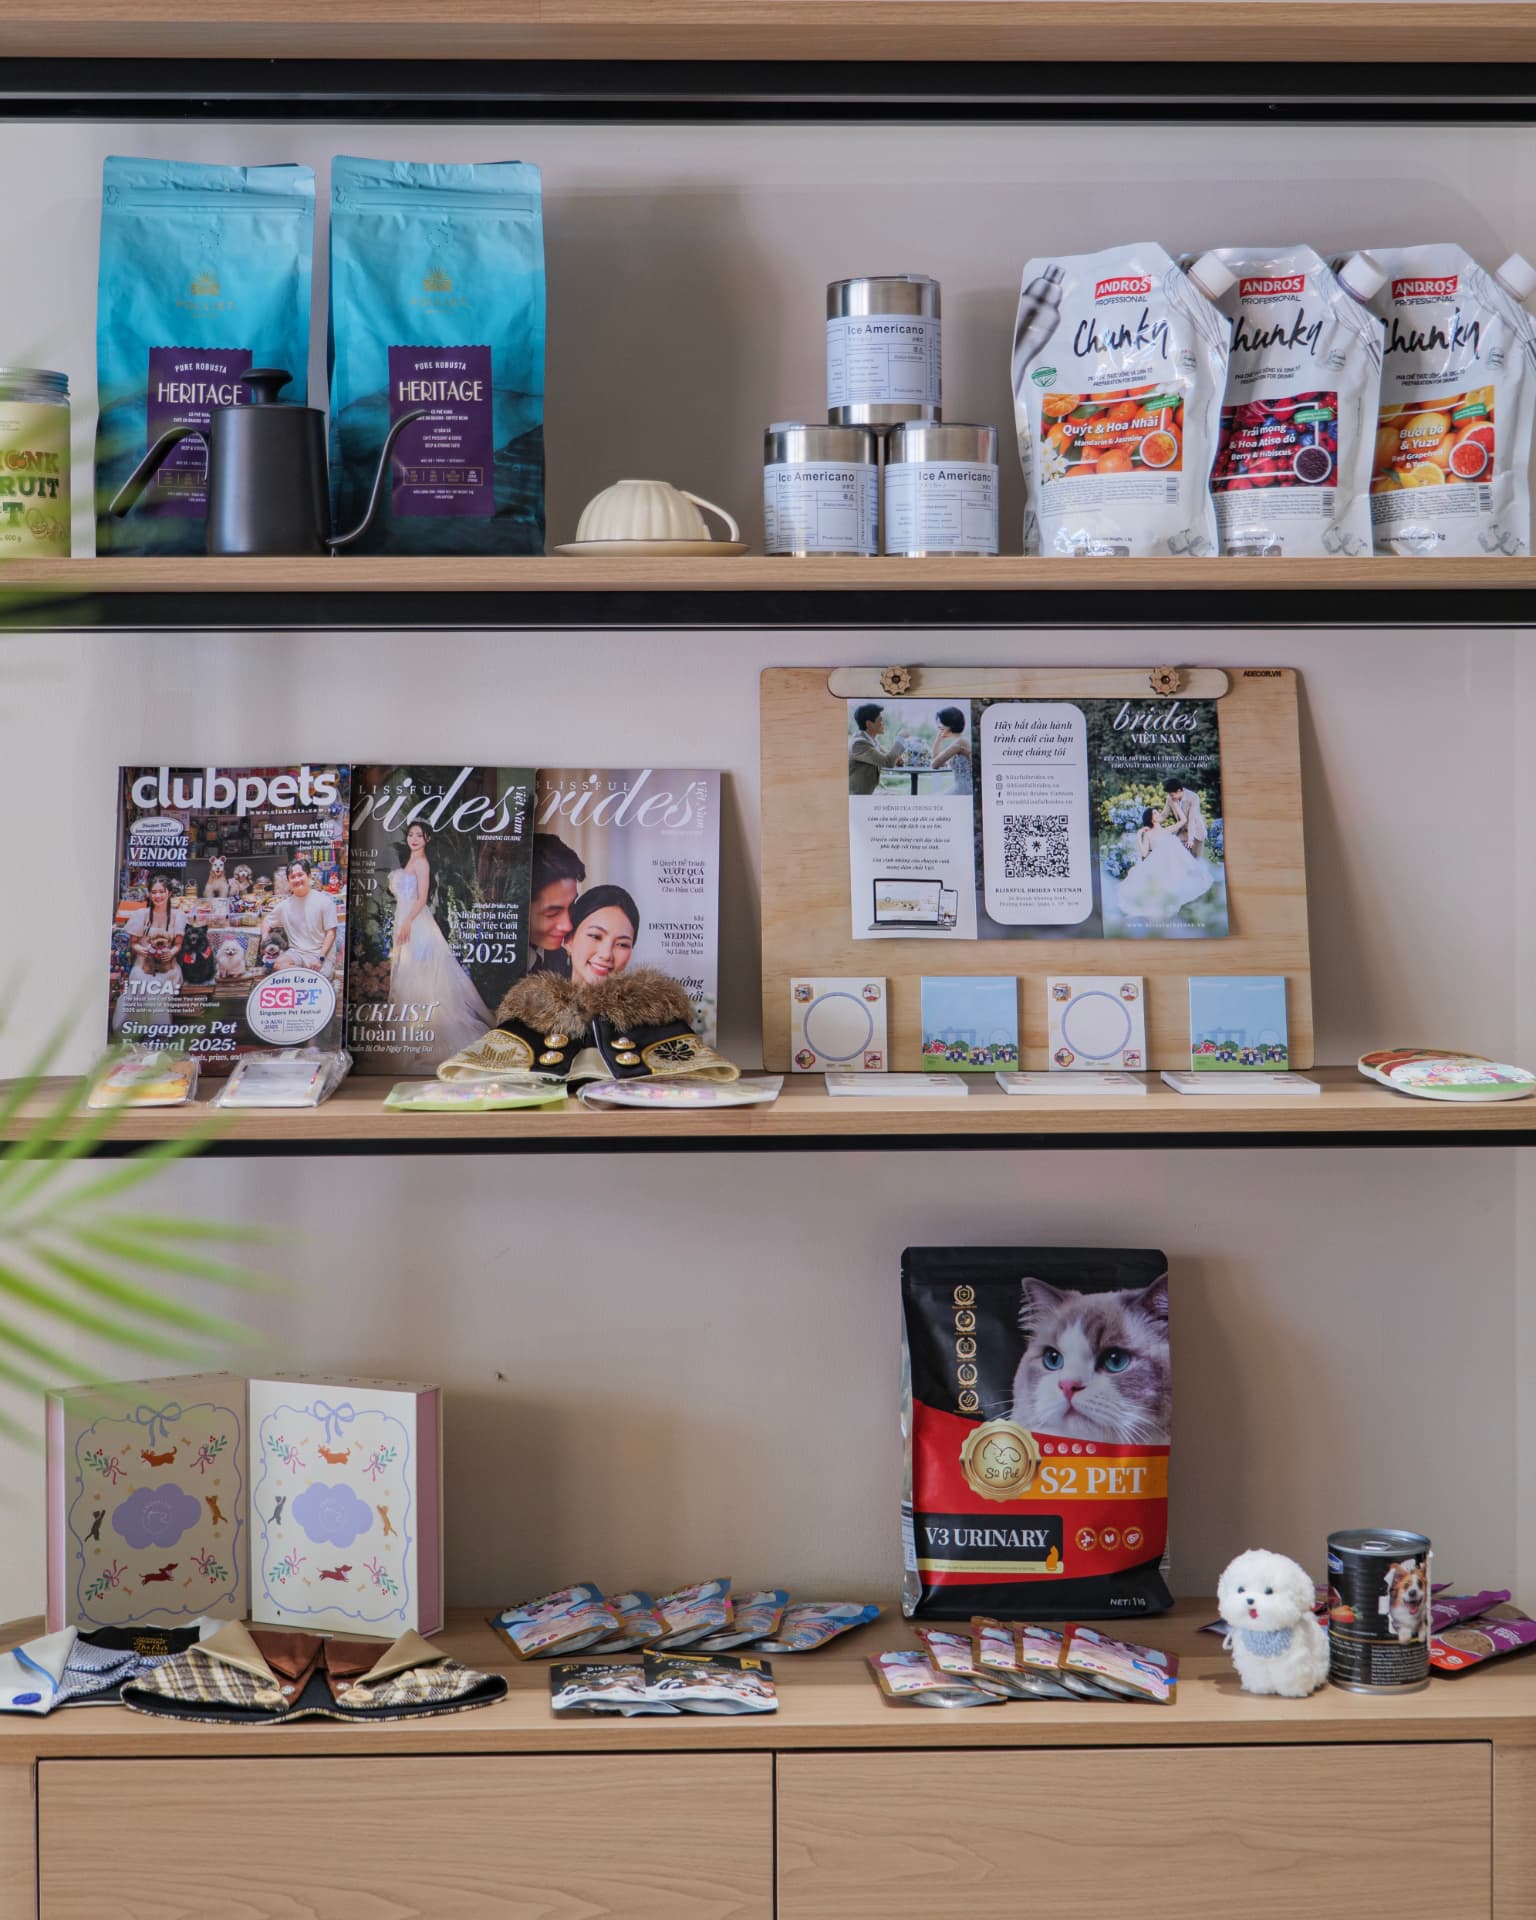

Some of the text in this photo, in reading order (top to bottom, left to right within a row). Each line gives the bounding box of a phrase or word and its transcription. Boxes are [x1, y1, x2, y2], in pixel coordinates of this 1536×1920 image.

[1097, 277, 1149, 296] ANDROS
[1242, 277, 1302, 294] ANDROS
[1395, 278, 1456, 296] ANDROS
[1095, 294, 1148, 306] PROFESSIONAL
[1241, 294, 1302, 305] PROFESSIONAL
[1394, 294, 1456, 306] PROFESSIONAL
[848, 323, 925, 335] Ice Americano
[1074, 307, 1169, 361] Chunky
[175, 362, 227, 374] PURE ROBUSTA
[415, 361, 467, 371] PURE ROBUSTA
[158, 382, 243, 405] HERITAGE
[399, 380, 484, 401] HERITAGE
[1063, 424, 1092, 437] Quýt
[1095, 424, 1105, 433] &
[1106, 421, 1129, 433] Hoa
[1242, 424, 1287, 437] Trái mọng
[1074, 438, 1107, 446] Mandarin
[1115, 435, 1143, 443] Jasmine
[1238, 440, 1257, 449] Hoa
[1259, 436, 1281, 447] Atiso
[1413, 439, 1440, 449] Yuzu
[1231, 453, 1250, 461] Berry
[778, 471, 855, 482] Ice Americano
[919, 470, 992, 482] Ice Americano
[0, 475, 60, 498] RUIT
[1113, 701, 1199, 731] brides
[994, 721, 1012, 731] Hãy
[1049, 720, 1072, 730] hành
[993, 733, 1016, 743] trình
[1039, 734, 1055, 743] của
[1056, 733, 1073, 744] bạn
[1131, 731, 1186, 744] VIỆT NAM
[1002, 747, 1066, 757] cùng chúng tôi
[131, 766, 337, 816] clubpets
[359, 784, 446, 795] LISSFUL
[546, 781, 631, 791] LISSFUL
[351, 766, 515, 833] rides
[537, 769, 697, 828] rides
[514, 785, 526, 834] Việt Nam
[287, 822, 308, 831] Time
[130, 835, 189, 846] EXCLUSIVE
[274, 830, 333, 839] PET FESTIVAL?
[130, 848, 187, 860] VENDOR
[648, 922, 704, 930] DESTINATION
[664, 932, 704, 940] WEDDING
[463, 943, 517, 964] 2025
[271, 977, 290, 985] Join
[294, 975, 305, 984] Us
[260, 986, 323, 1008] SGPF
[348, 1001, 439, 1021] ECKLIST
[121, 1021, 239, 1037] Singapore Pet
[353, 1024, 396, 1041] Hoàn
[189, 1039, 237, 1051] 2025:
[984, 1466, 1020, 1480] S2 Pet
[1040, 1466, 1147, 1494] S2 PET
[925, 1527, 1049, 1547] V3 URINARY
